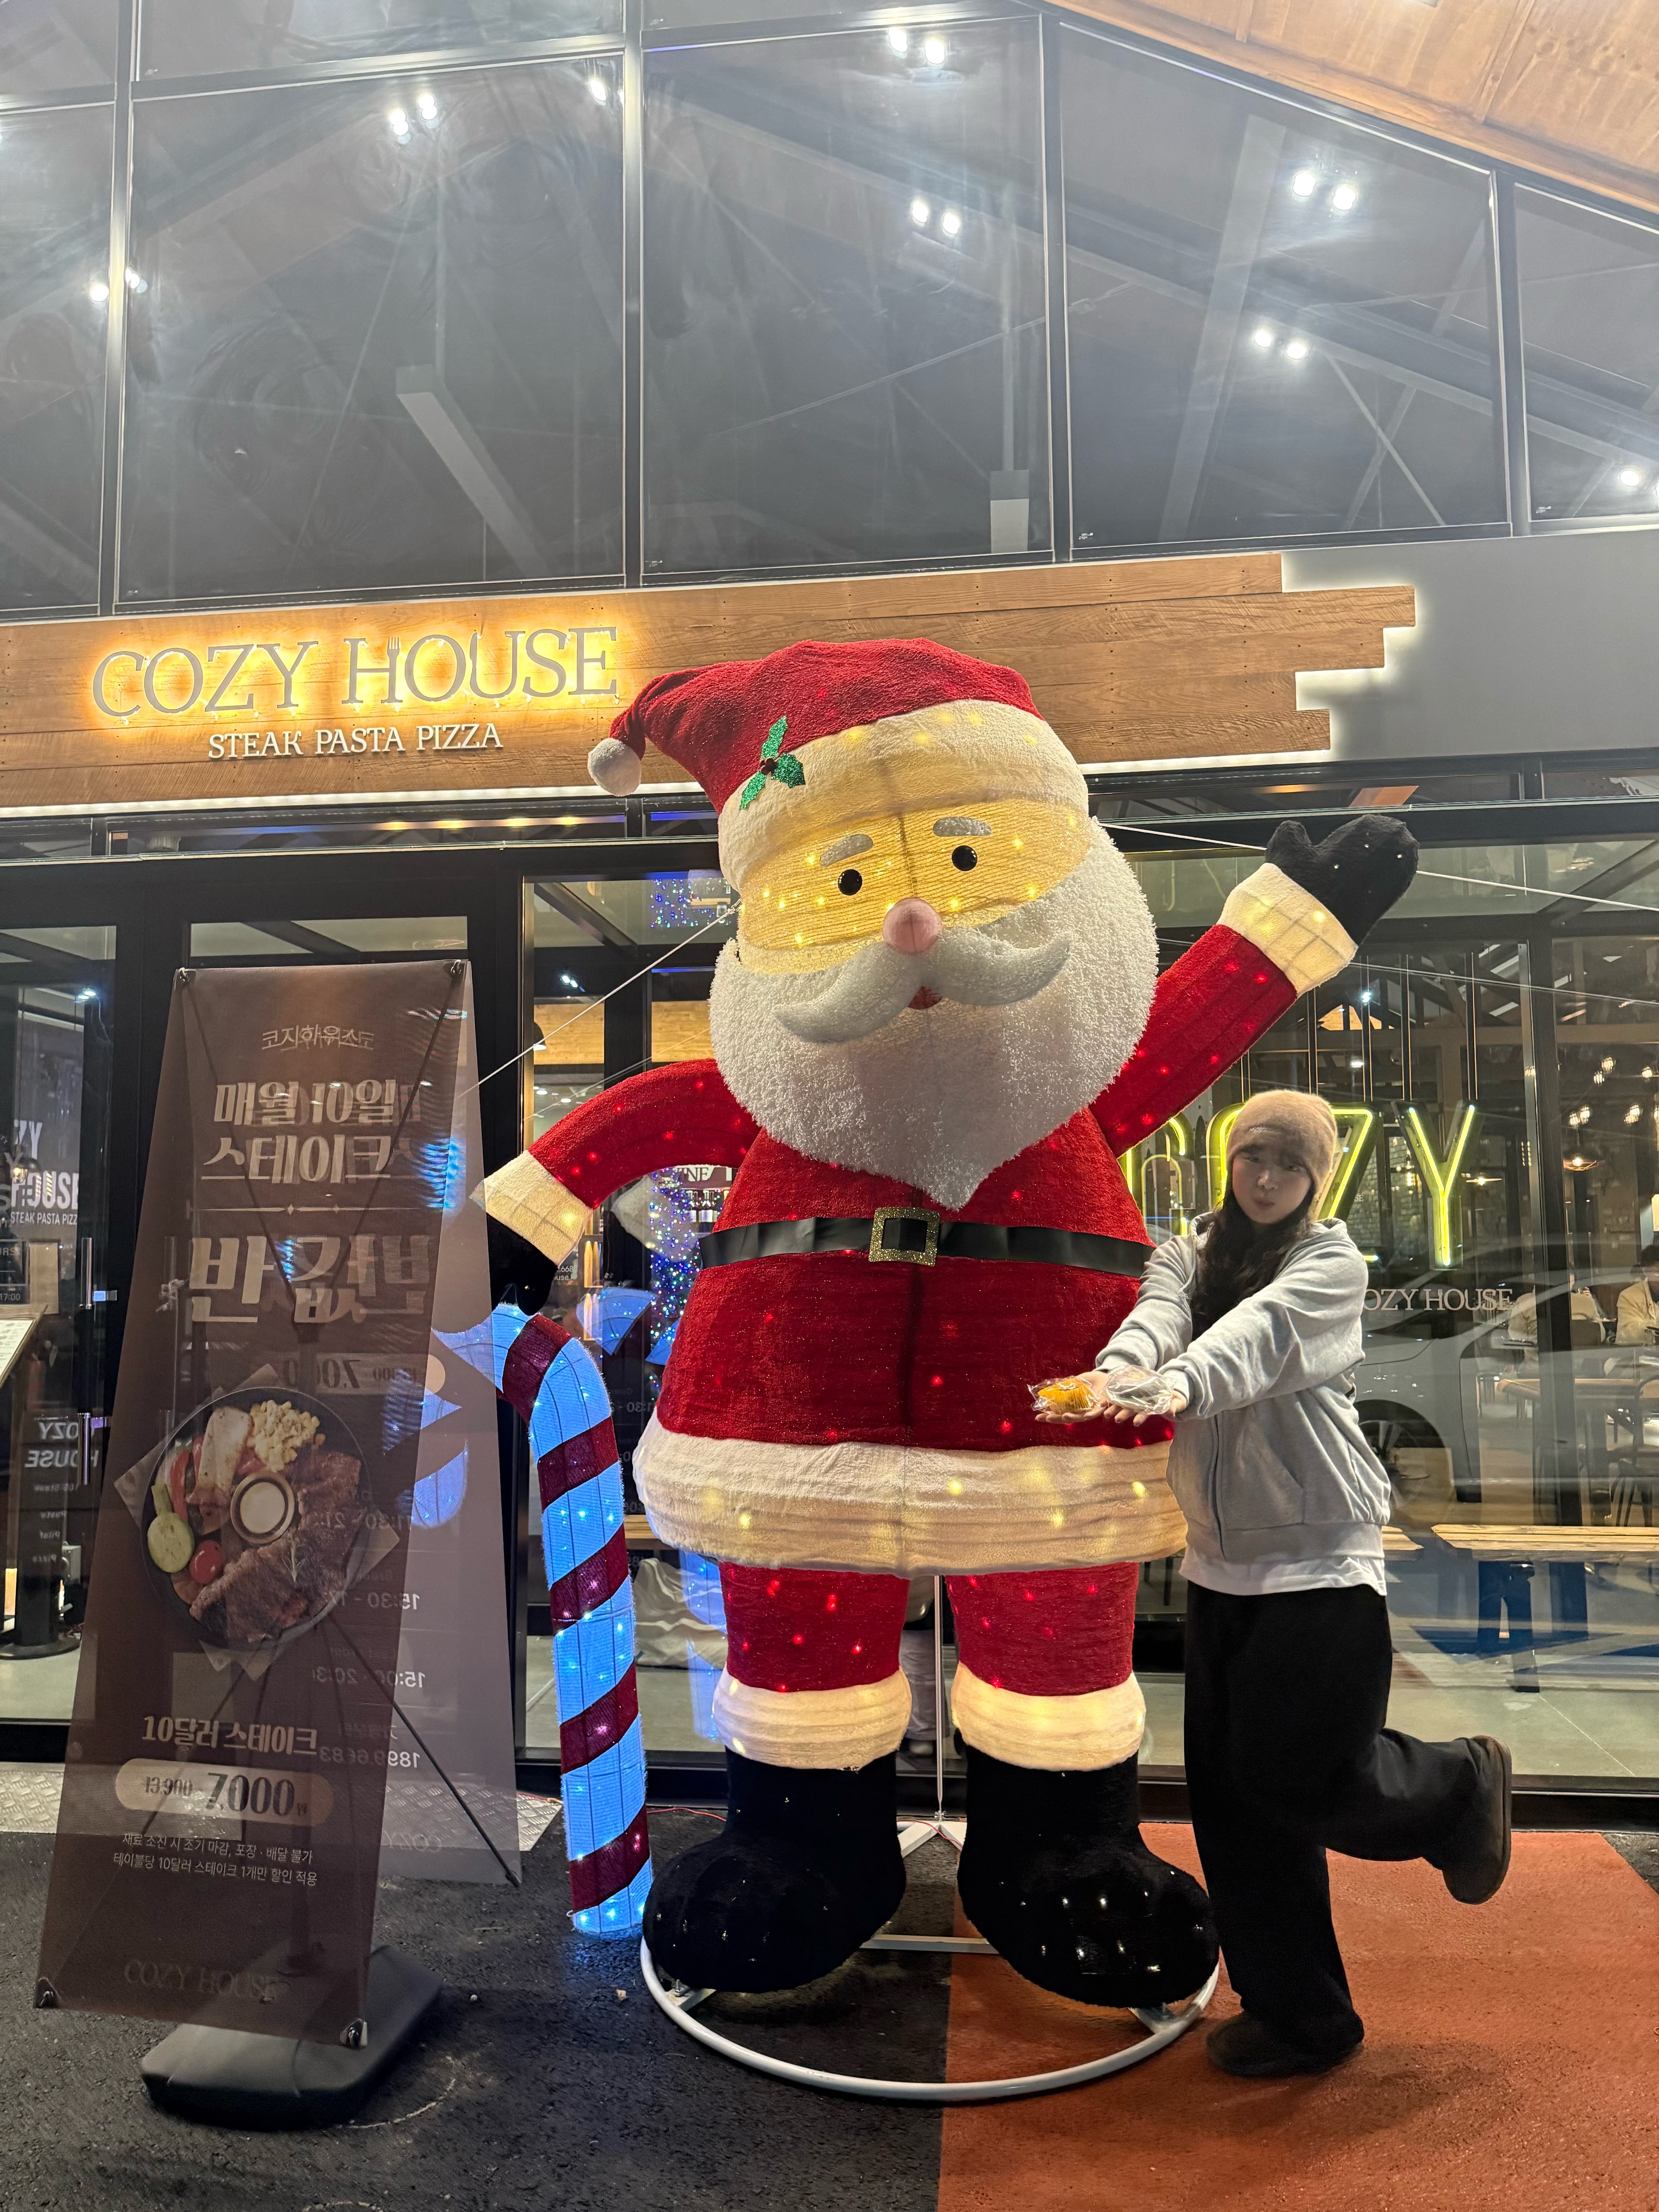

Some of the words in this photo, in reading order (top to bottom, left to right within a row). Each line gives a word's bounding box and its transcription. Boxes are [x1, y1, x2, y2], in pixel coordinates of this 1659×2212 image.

[93, 641, 319, 718] COZY
[342, 626, 618, 706] HOUSE
[208, 730, 302, 760] STEAK
[315, 725, 404, 755] PASTA
[416, 722, 504, 751] PIZZA
[214, 1082, 300, 1125] 매월
[312, 1079, 396, 1124] 10일
[201, 1133, 392, 1184] 스테이크
[10, 1211, 35, 1224] STEAK
[37, 1212, 60, 1225] PASTA
[62, 1213, 78, 1225] PIZZ
[1362, 1289, 1419, 1311] OZY
[1423, 1288, 1513, 1311] HOUSE
[142, 1716, 219, 1748] 10달러
[223, 1722, 317, 1755] 스테이크
[146, 1835, 167, 1849] 소진
[170, 1837, 180, 1851] 시
[184, 1838, 205, 1853] 조기
[235, 1843, 257, 1858] 포장
[266, 1847, 288, 1861] 배달
[291, 1848, 313, 1865] 불가
[158, 1856, 192, 1873] 10달러
[195, 1860, 237, 1877] 스테이크
[271, 1868, 292, 1884] 할인
[296, 1870, 317, 1887] 적용
